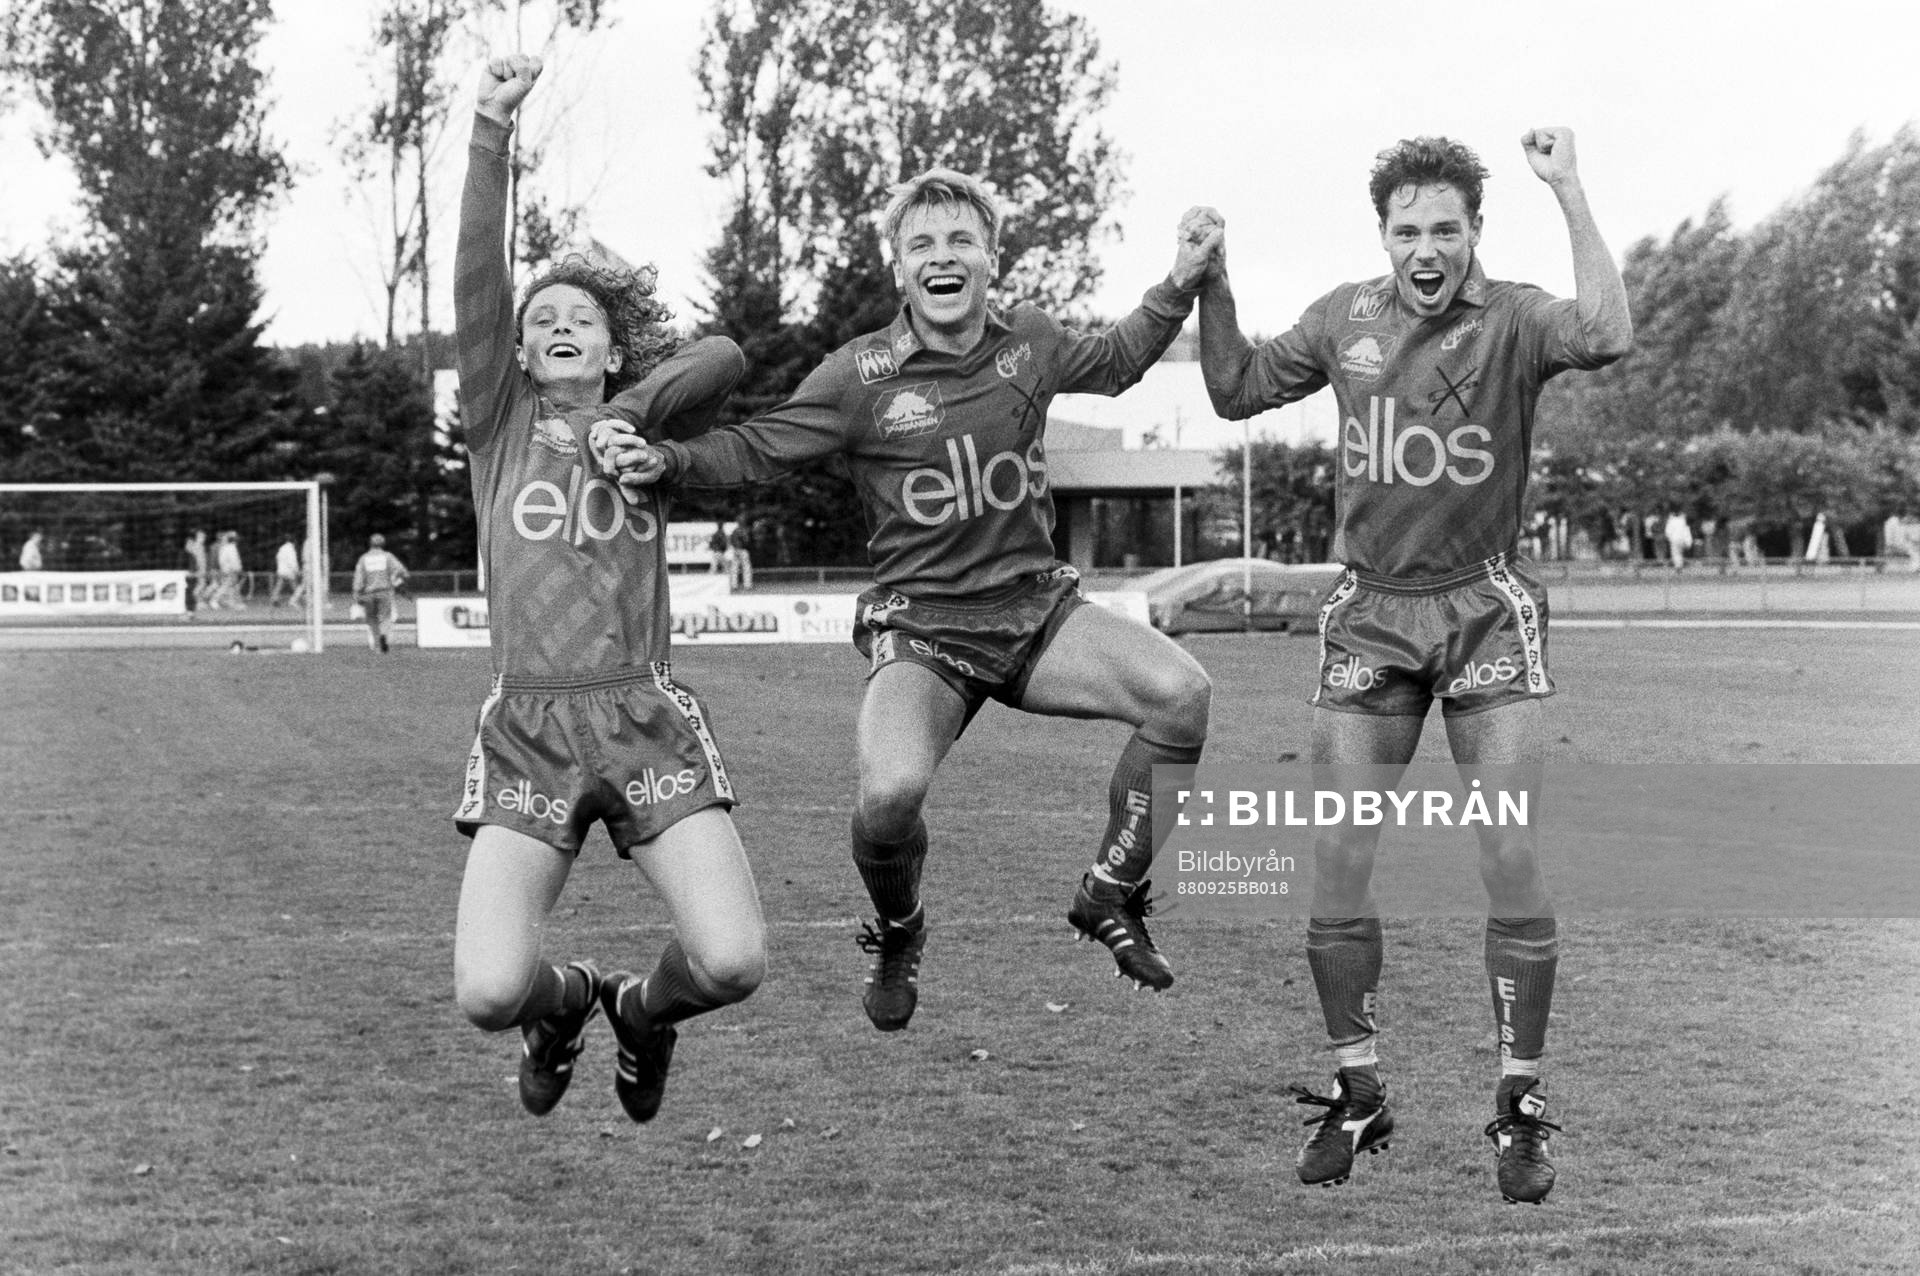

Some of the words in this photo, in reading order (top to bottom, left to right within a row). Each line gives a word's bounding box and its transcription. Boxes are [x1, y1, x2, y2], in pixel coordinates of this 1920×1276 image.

[1344, 396, 1495, 487] ellos
[902, 434, 1048, 526] ellos
[1328, 656, 1389, 691] ellos
[1449, 656, 1517, 694] ellos
[497, 778, 570, 825] ellos
[626, 767, 698, 807] ellos
